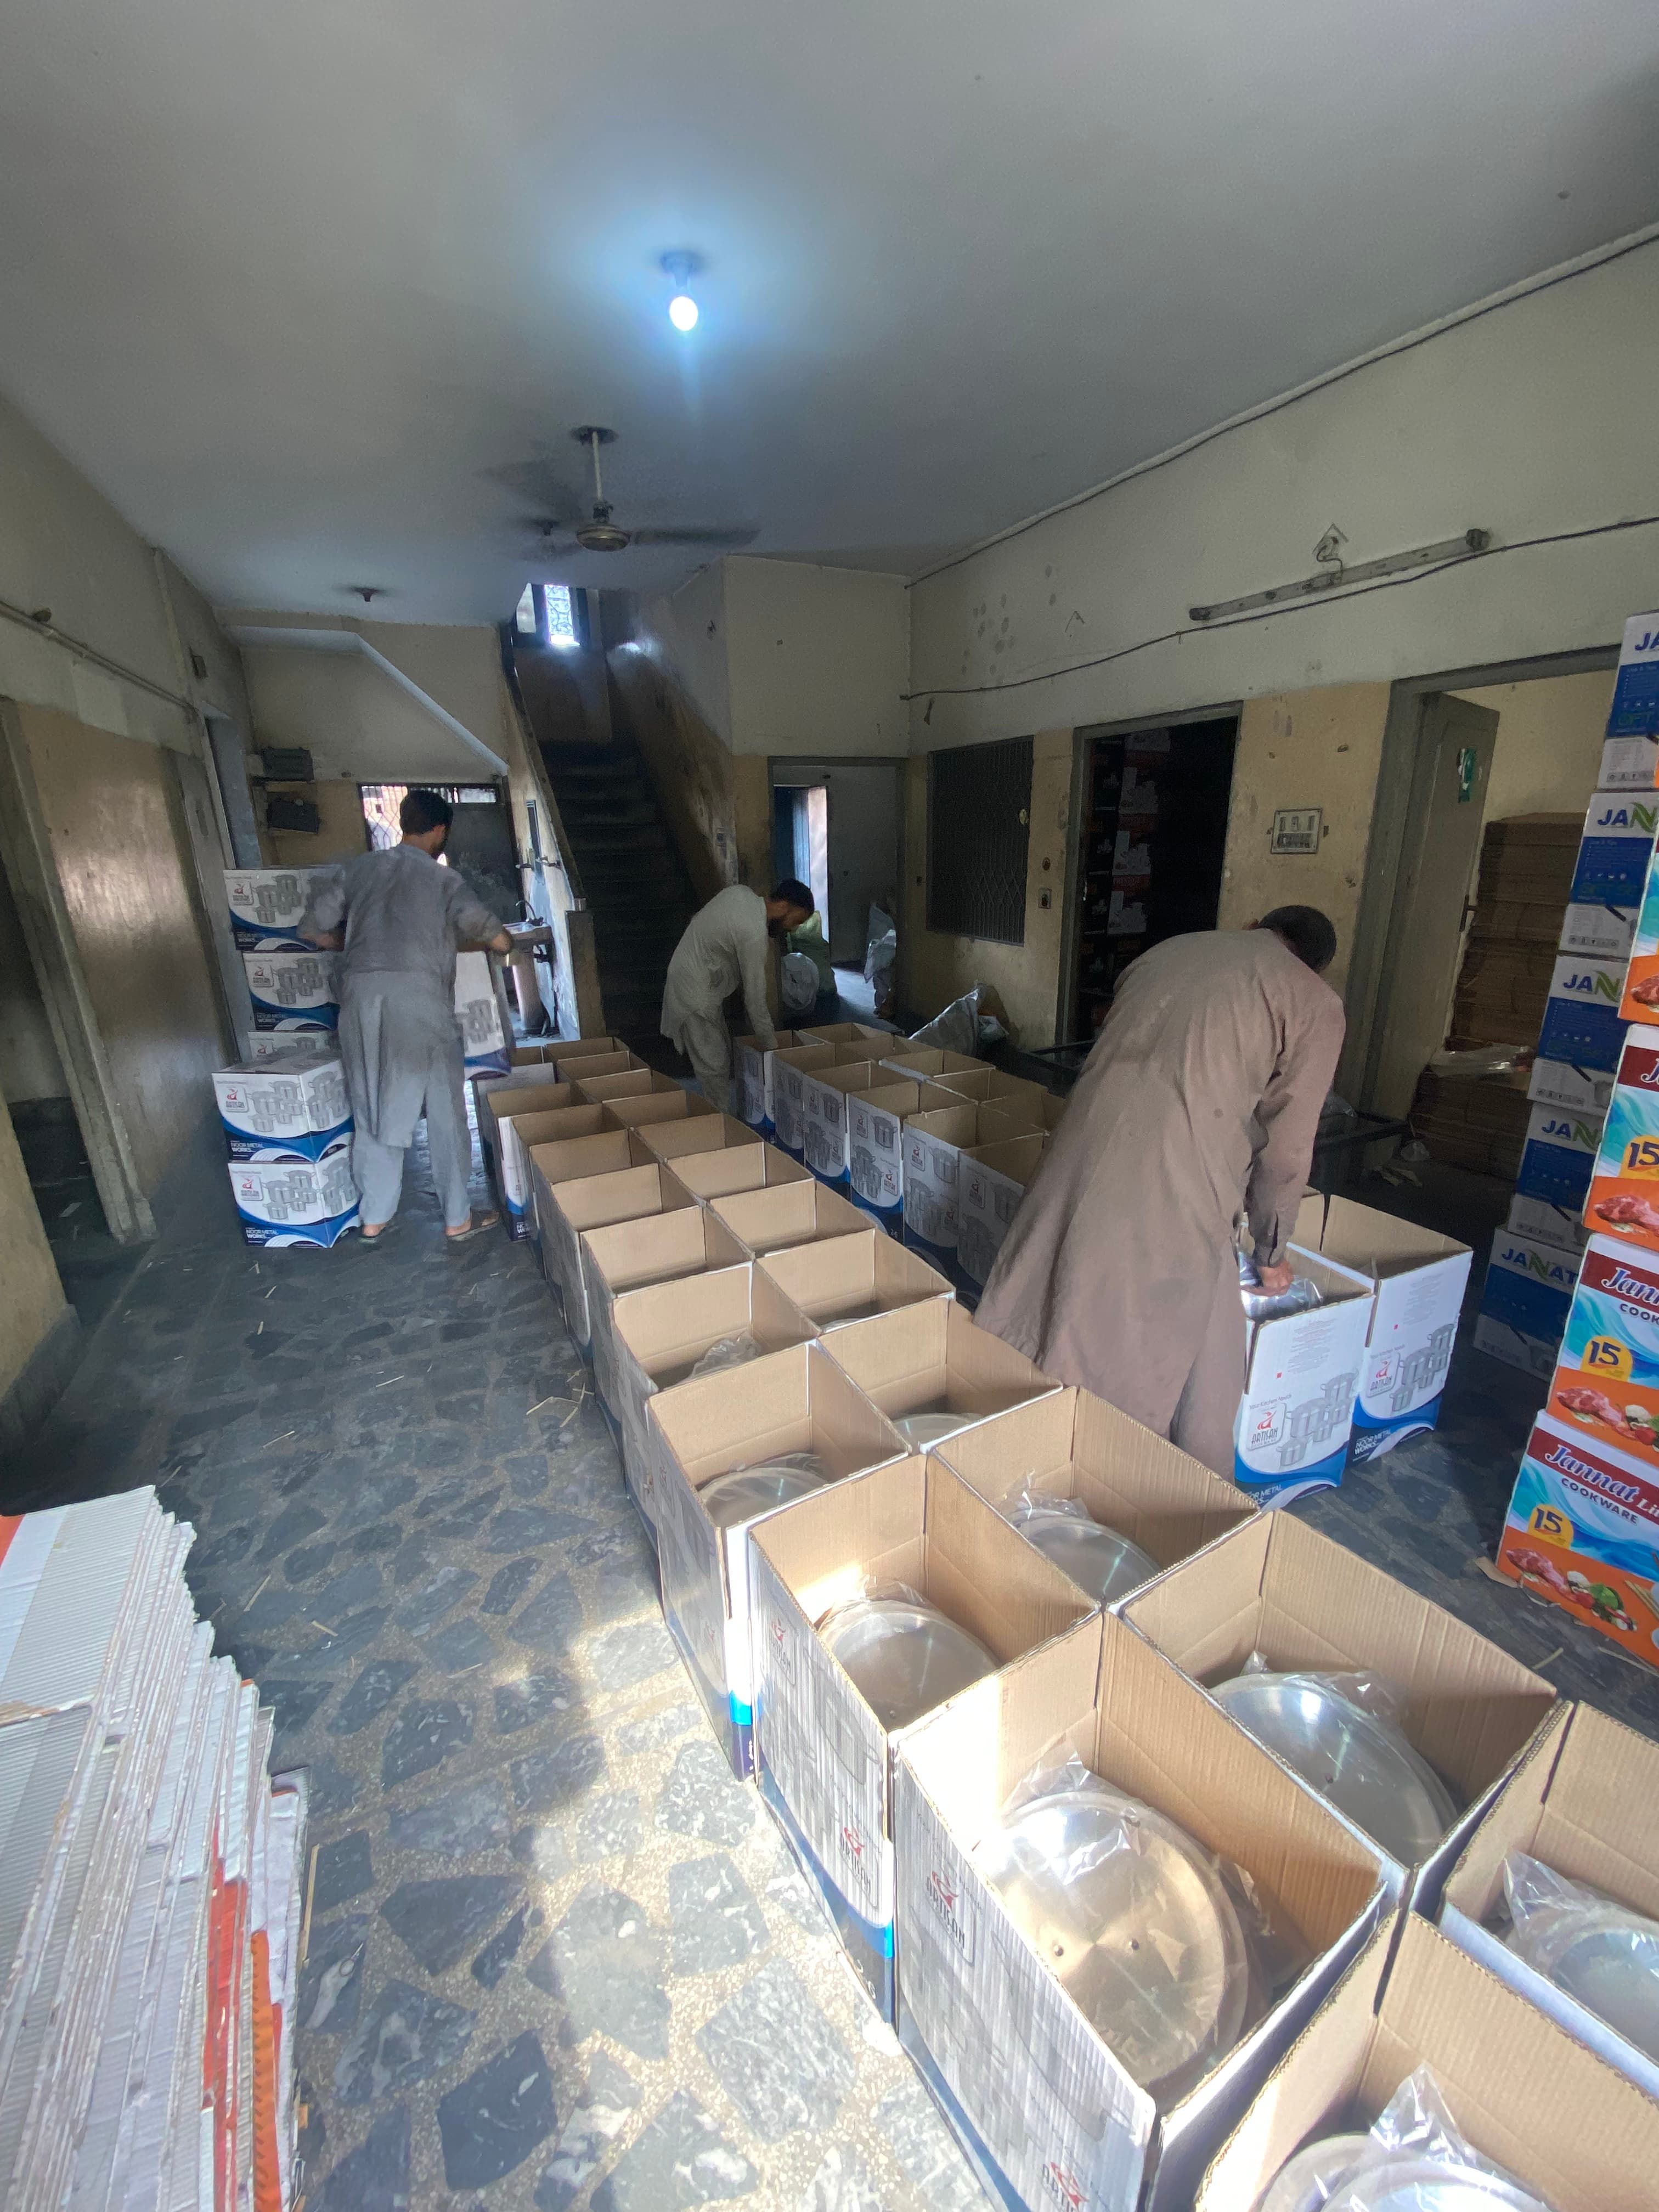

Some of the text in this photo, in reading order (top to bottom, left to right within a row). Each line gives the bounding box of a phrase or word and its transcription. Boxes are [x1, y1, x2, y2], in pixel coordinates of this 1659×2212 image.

[1628, 1141, 1659, 1168] 15
[1501, 1248, 1578, 1284] JANAT
[1589, 1340, 1621, 1366] 15
[1251, 1427, 1278, 1444] ARTISAN
[1545, 1443, 1640, 1503] Jannat
[1260, 1484, 1283, 1497] METAL
[1561, 1477, 1639, 1525] COOKWARE
[1534, 1507, 1564, 1533] 15
[927, 1875, 964, 1949] ARTISAN
